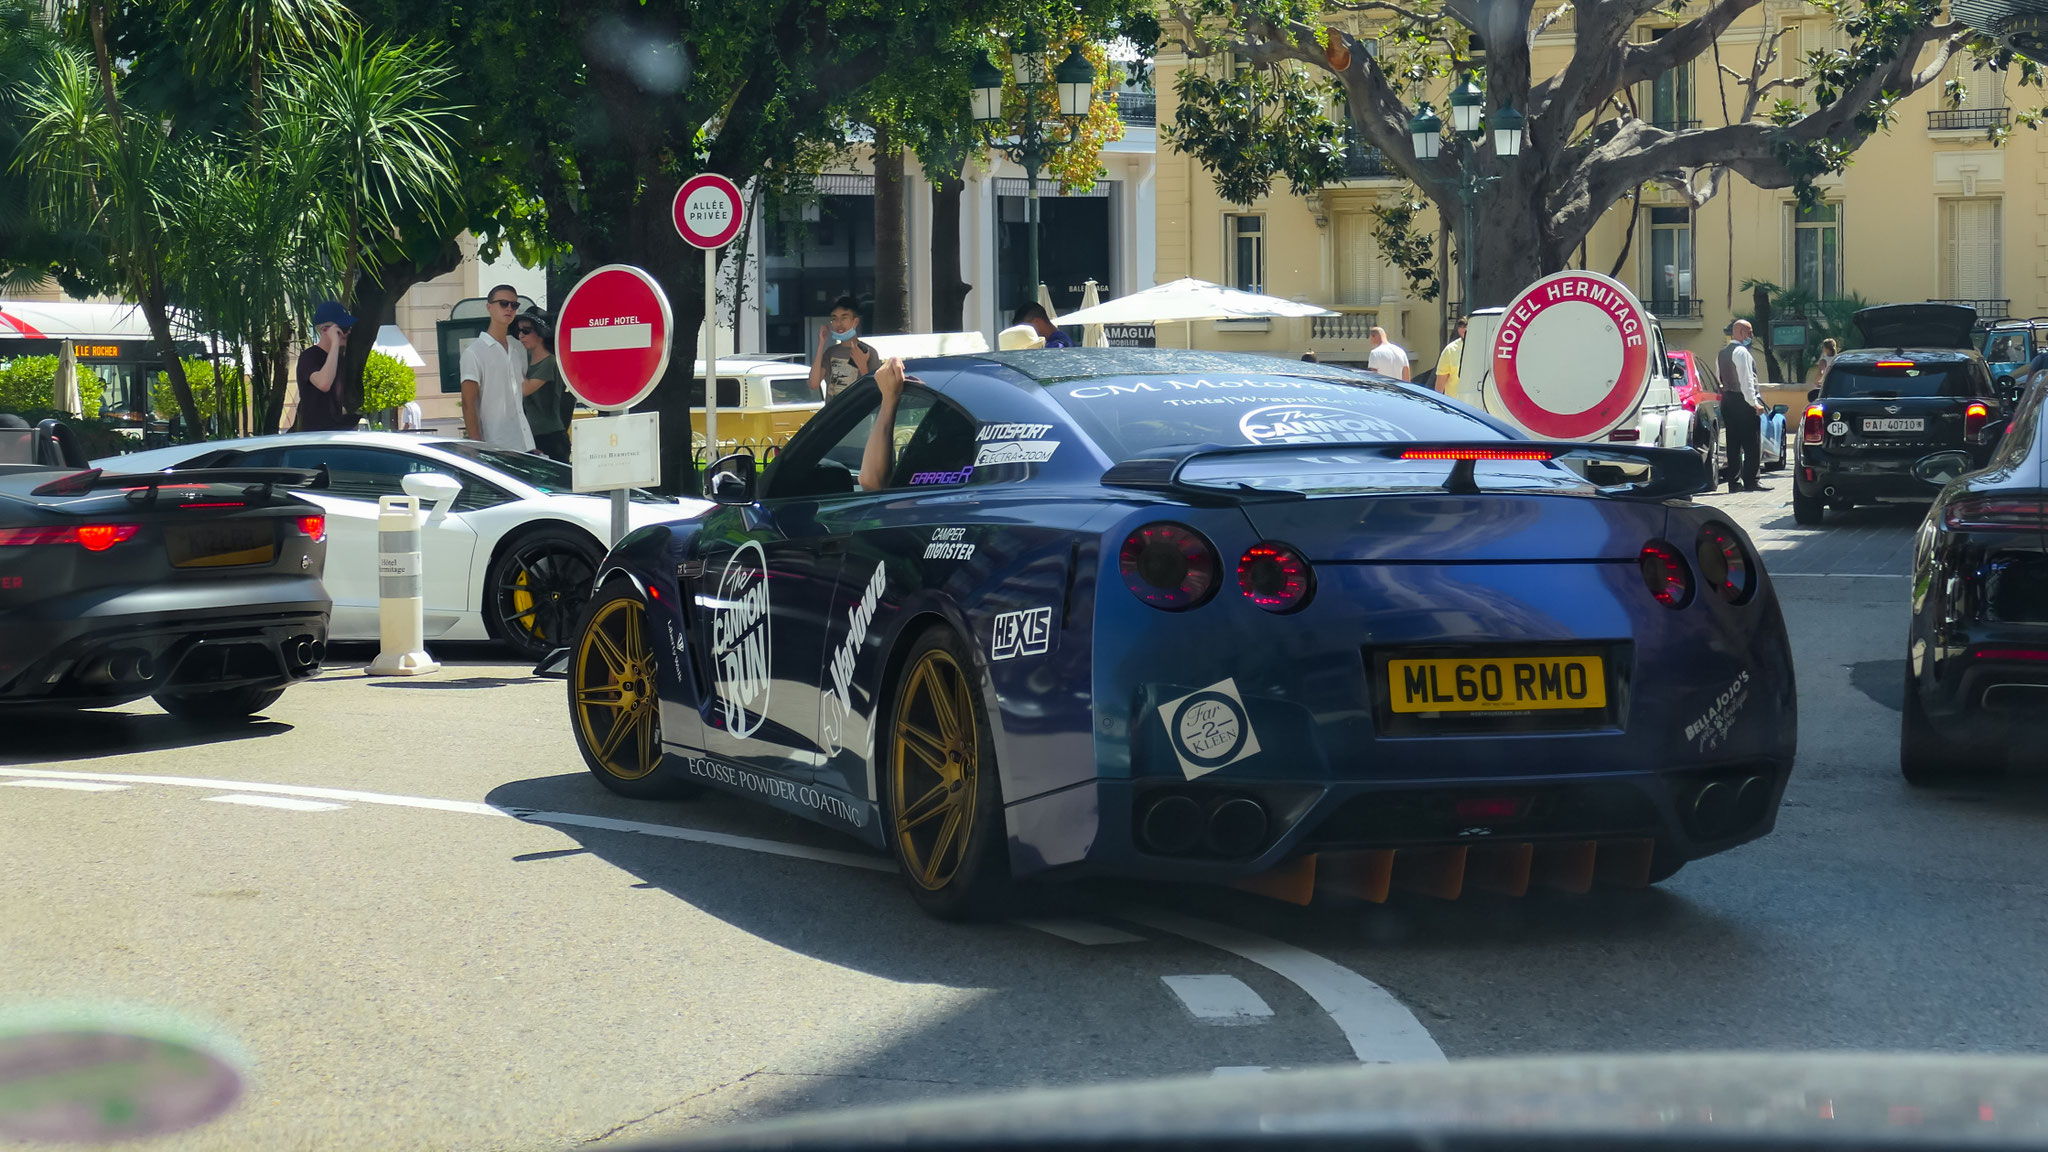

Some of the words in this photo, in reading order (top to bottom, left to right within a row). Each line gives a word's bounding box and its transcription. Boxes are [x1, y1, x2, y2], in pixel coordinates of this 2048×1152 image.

[693, 200, 725, 210] ALLÉE
[690, 210, 727, 220] PRIVÉE
[1068, 285, 1109, 293] BALEAGA
[588, 317, 610, 327] SAUF
[614, 315, 640, 325] HOTEL
[1498, 298, 1541, 359] HOTEL
[1546, 281, 1642, 347] HERMITAGE
[80, 346, 90, 357] LE
[92, 345, 119, 357] ROCHER
[1069, 382, 1162, 399] CM
[975, 423, 1054, 442] AUTOSPORT
[1831, 423, 1844, 434] CH
[1887, 421, 1915, 430] 40710
[931, 527, 966, 541] CAMPER
[830, 560, 887, 718] Varlowe
[992, 607, 1052, 660] HEXIS
[1403, 664, 1504, 703] ML60
[1513, 662, 1588, 701] RMO
[1186, 702, 1221, 727] Far
[1192, 729, 1237, 754] KLEEN
[688, 757, 738, 786] ECOSSE
[739, 770, 799, 803] POWDER
[800, 786, 862, 828] COATING
